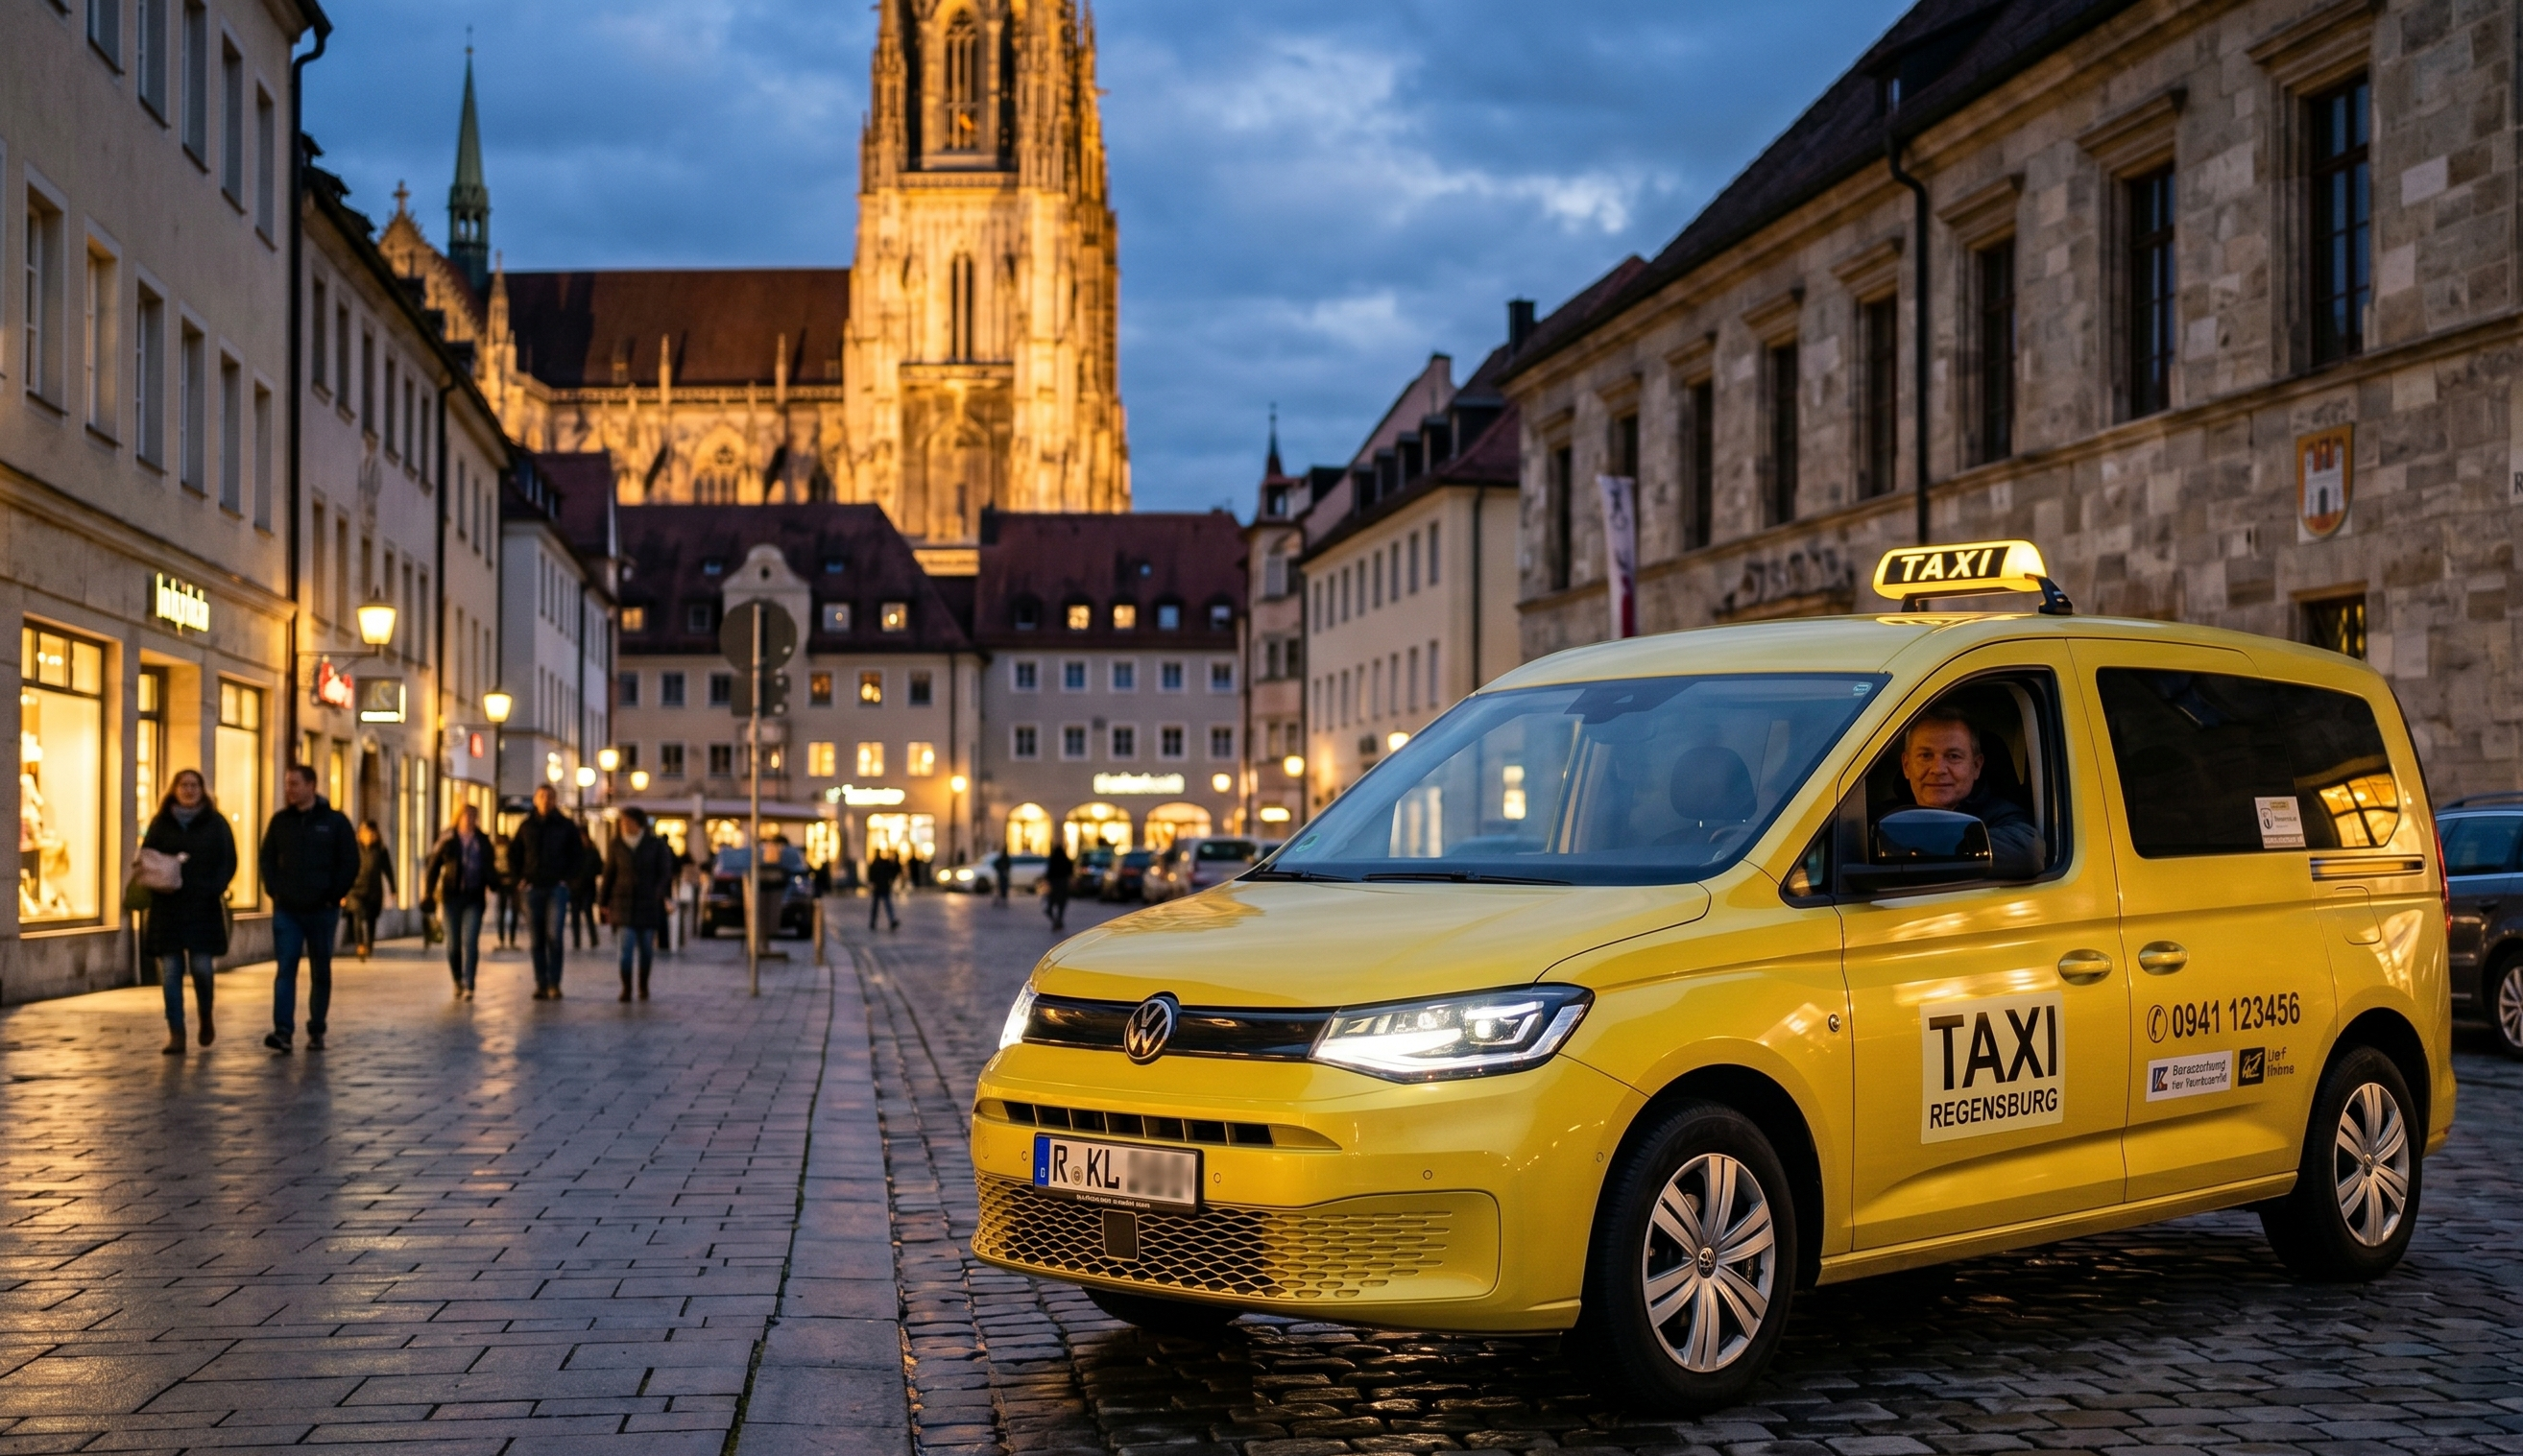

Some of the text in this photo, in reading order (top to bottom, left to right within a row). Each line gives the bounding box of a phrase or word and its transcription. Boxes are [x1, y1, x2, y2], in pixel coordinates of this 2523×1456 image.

[1900, 549, 1993, 582] TAXI
[2173, 991, 2300, 1039] 0941 123456
[1929, 1005, 2058, 1090] TAXI
[1930, 1087, 2058, 1130] REGENSBURG
[1052, 1144, 1069, 1183] R
[1087, 1147, 1120, 1190] KL
